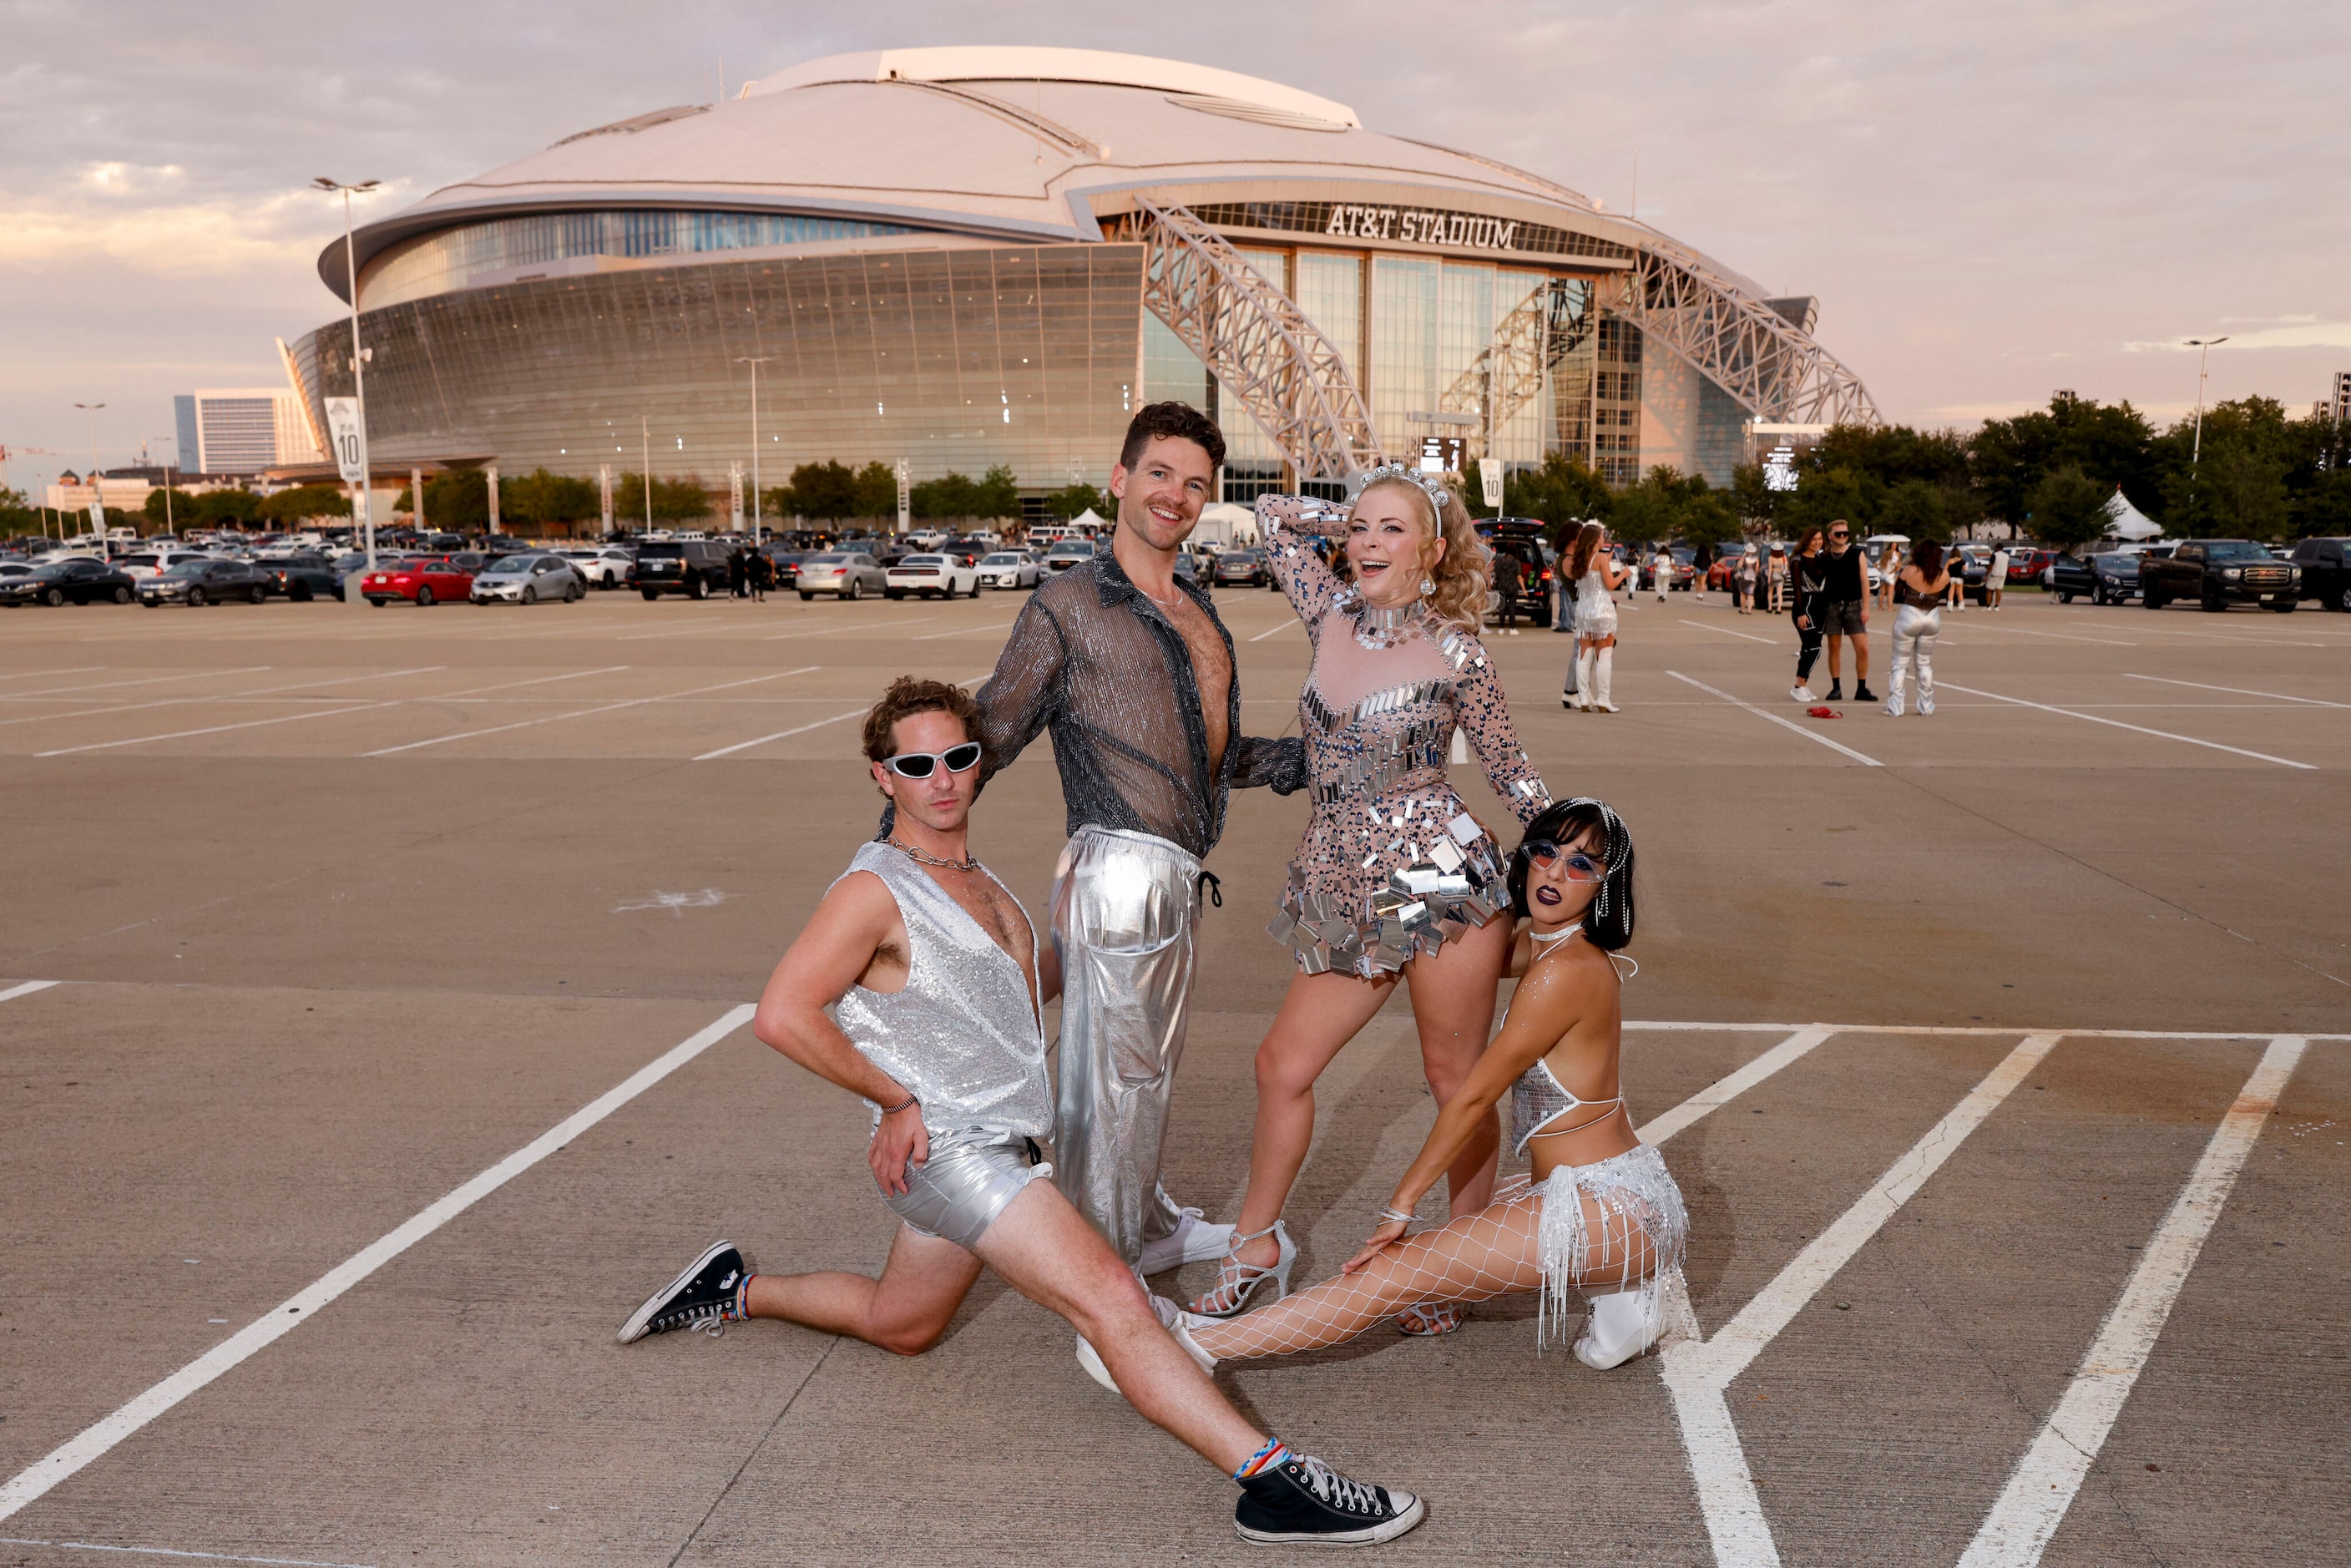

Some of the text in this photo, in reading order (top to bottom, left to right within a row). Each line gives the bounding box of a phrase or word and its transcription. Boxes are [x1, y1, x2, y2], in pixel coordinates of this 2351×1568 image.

[1326, 205, 1516, 250] AT&T STADIUM
[339, 435, 359, 465] 10
[1485, 480, 1499, 498] 10
